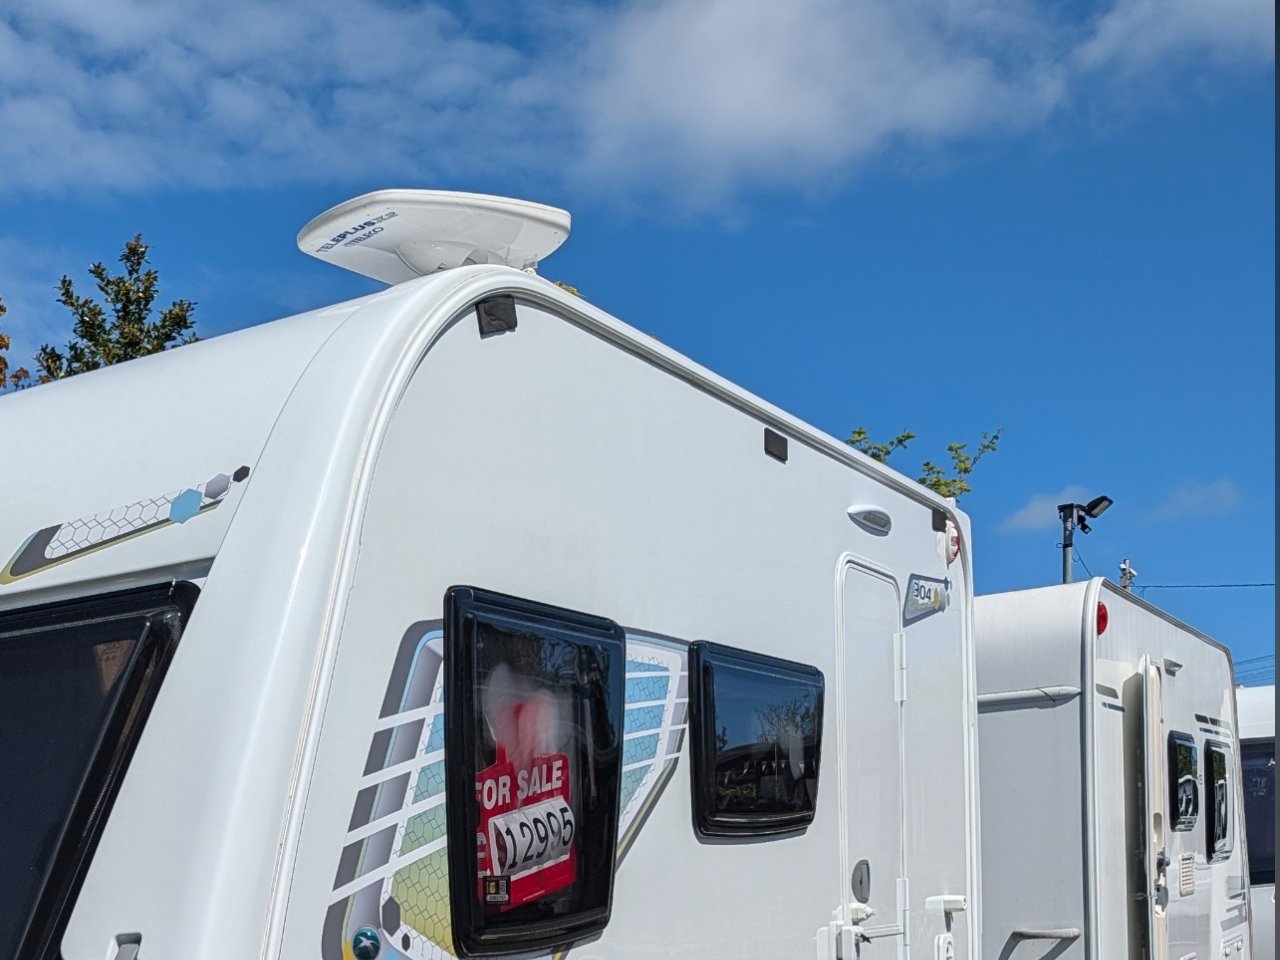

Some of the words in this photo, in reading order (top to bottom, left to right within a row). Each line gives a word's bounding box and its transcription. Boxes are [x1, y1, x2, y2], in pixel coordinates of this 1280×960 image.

[913, 582, 932, 602] 304
[517, 759, 563, 801] SALE
[505, 806, 574, 871] 12995
